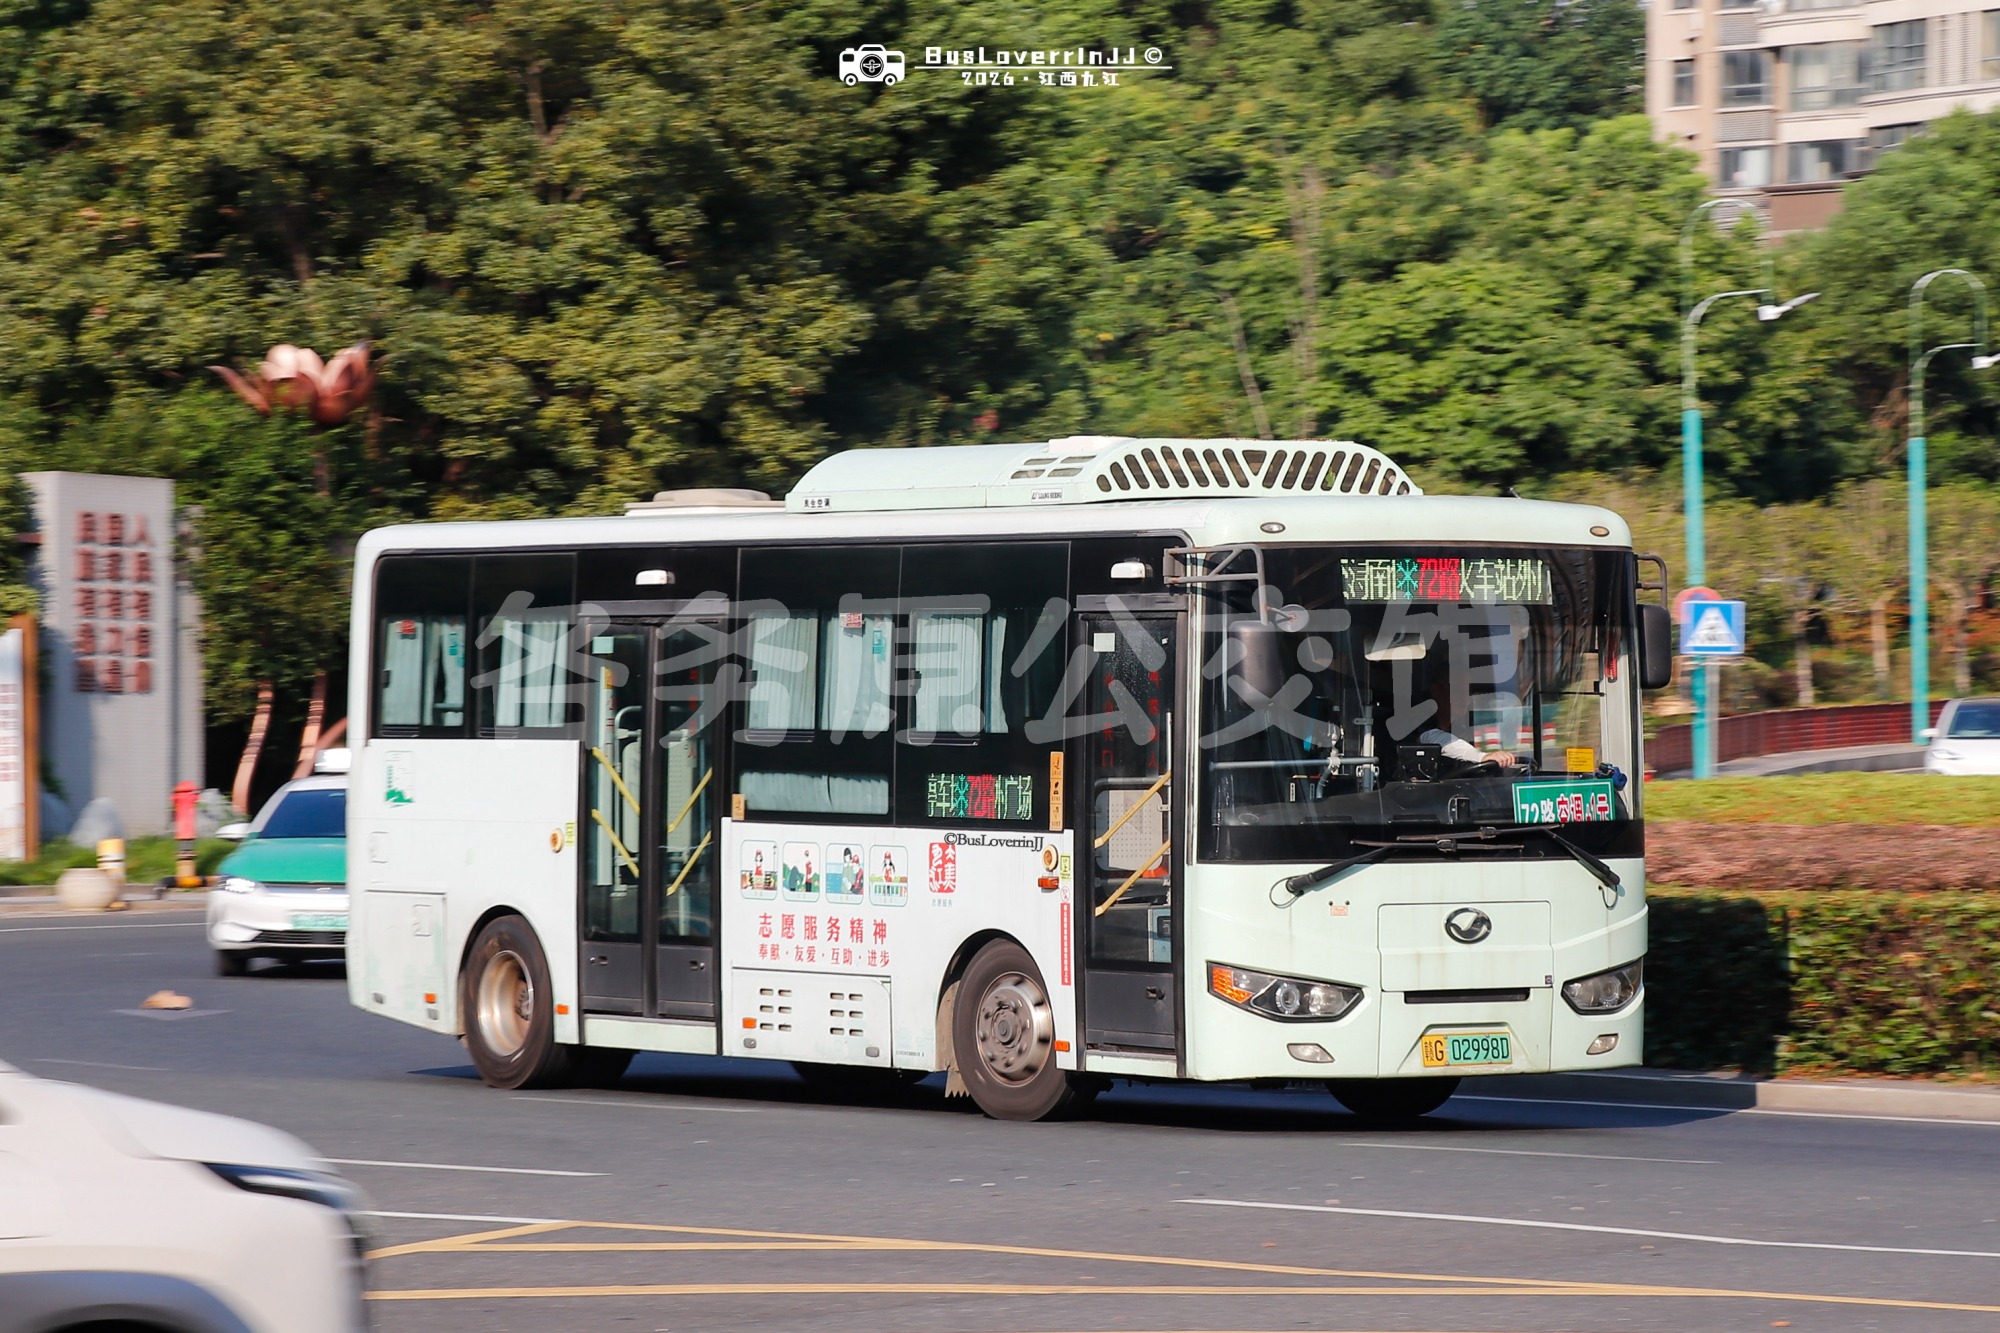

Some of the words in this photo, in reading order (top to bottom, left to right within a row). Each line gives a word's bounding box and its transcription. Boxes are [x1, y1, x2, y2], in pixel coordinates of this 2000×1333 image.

[758, 912, 887, 945] 志愿服务精神
